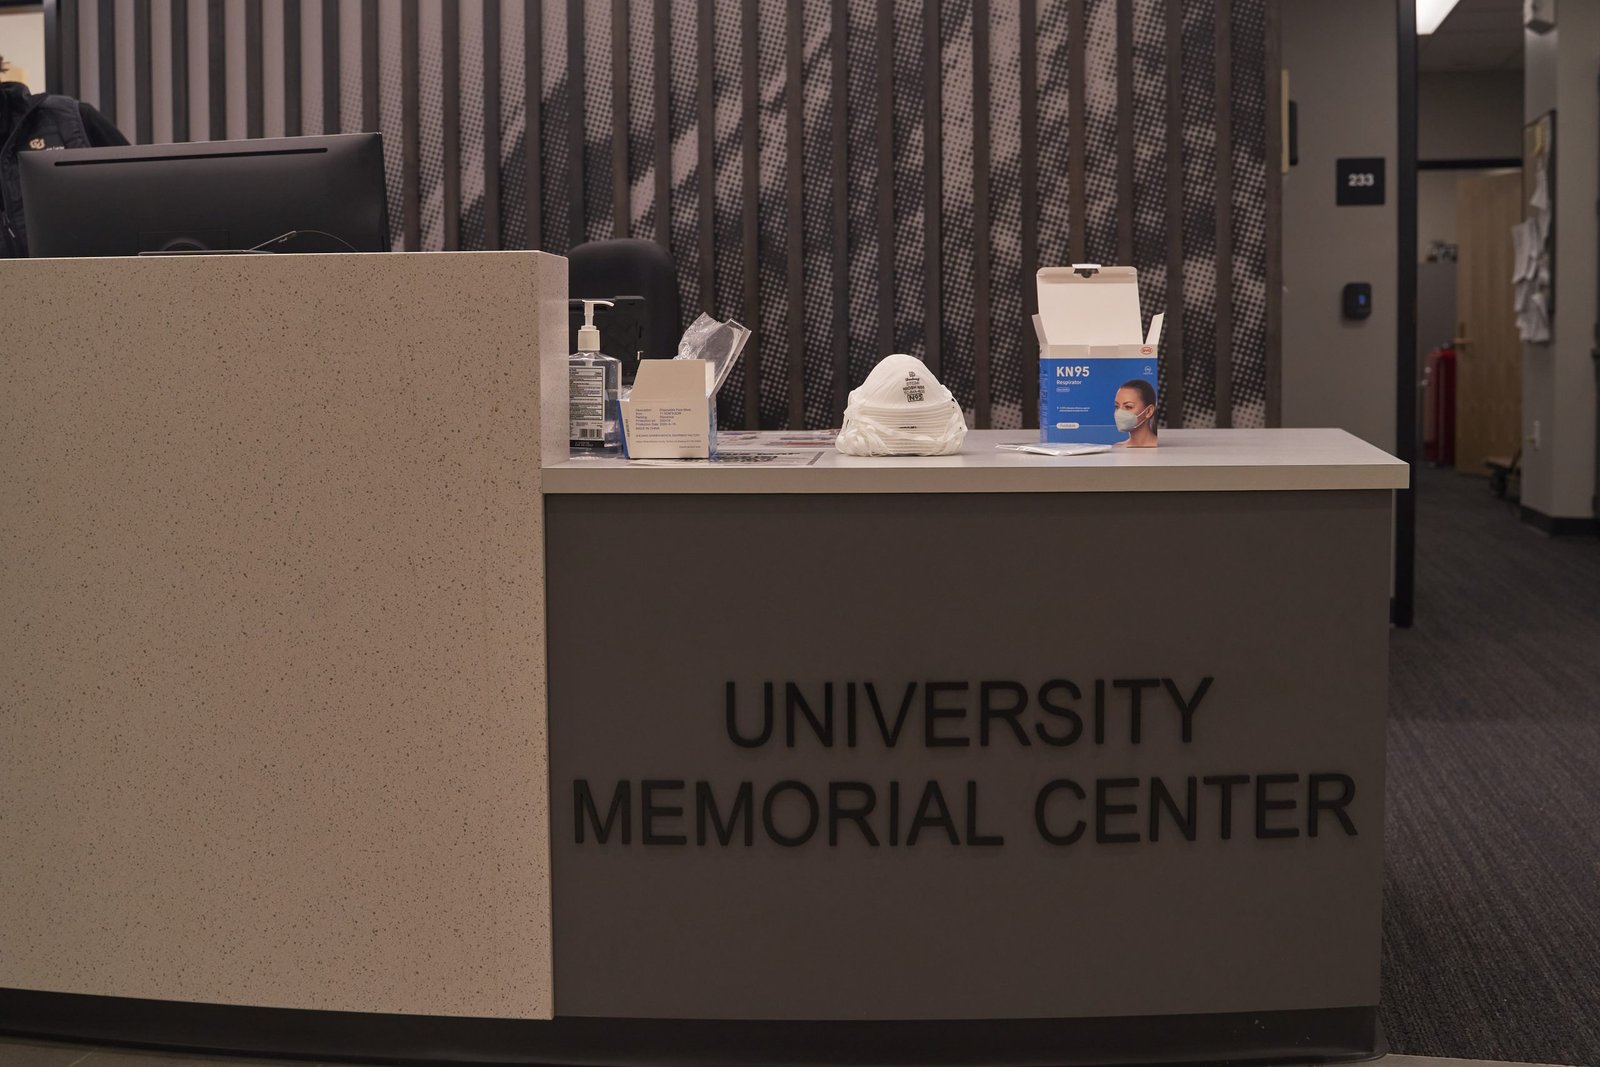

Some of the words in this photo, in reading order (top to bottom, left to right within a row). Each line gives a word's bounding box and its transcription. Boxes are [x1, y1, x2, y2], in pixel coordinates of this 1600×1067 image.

[1348, 173, 1375, 187] 233
[1056, 366, 1090, 378] KN95
[724, 677, 1214, 748] UNIVERSITY
[572, 778, 1005, 847] MEMORIAL
[1034, 772, 1359, 844] CENTER
